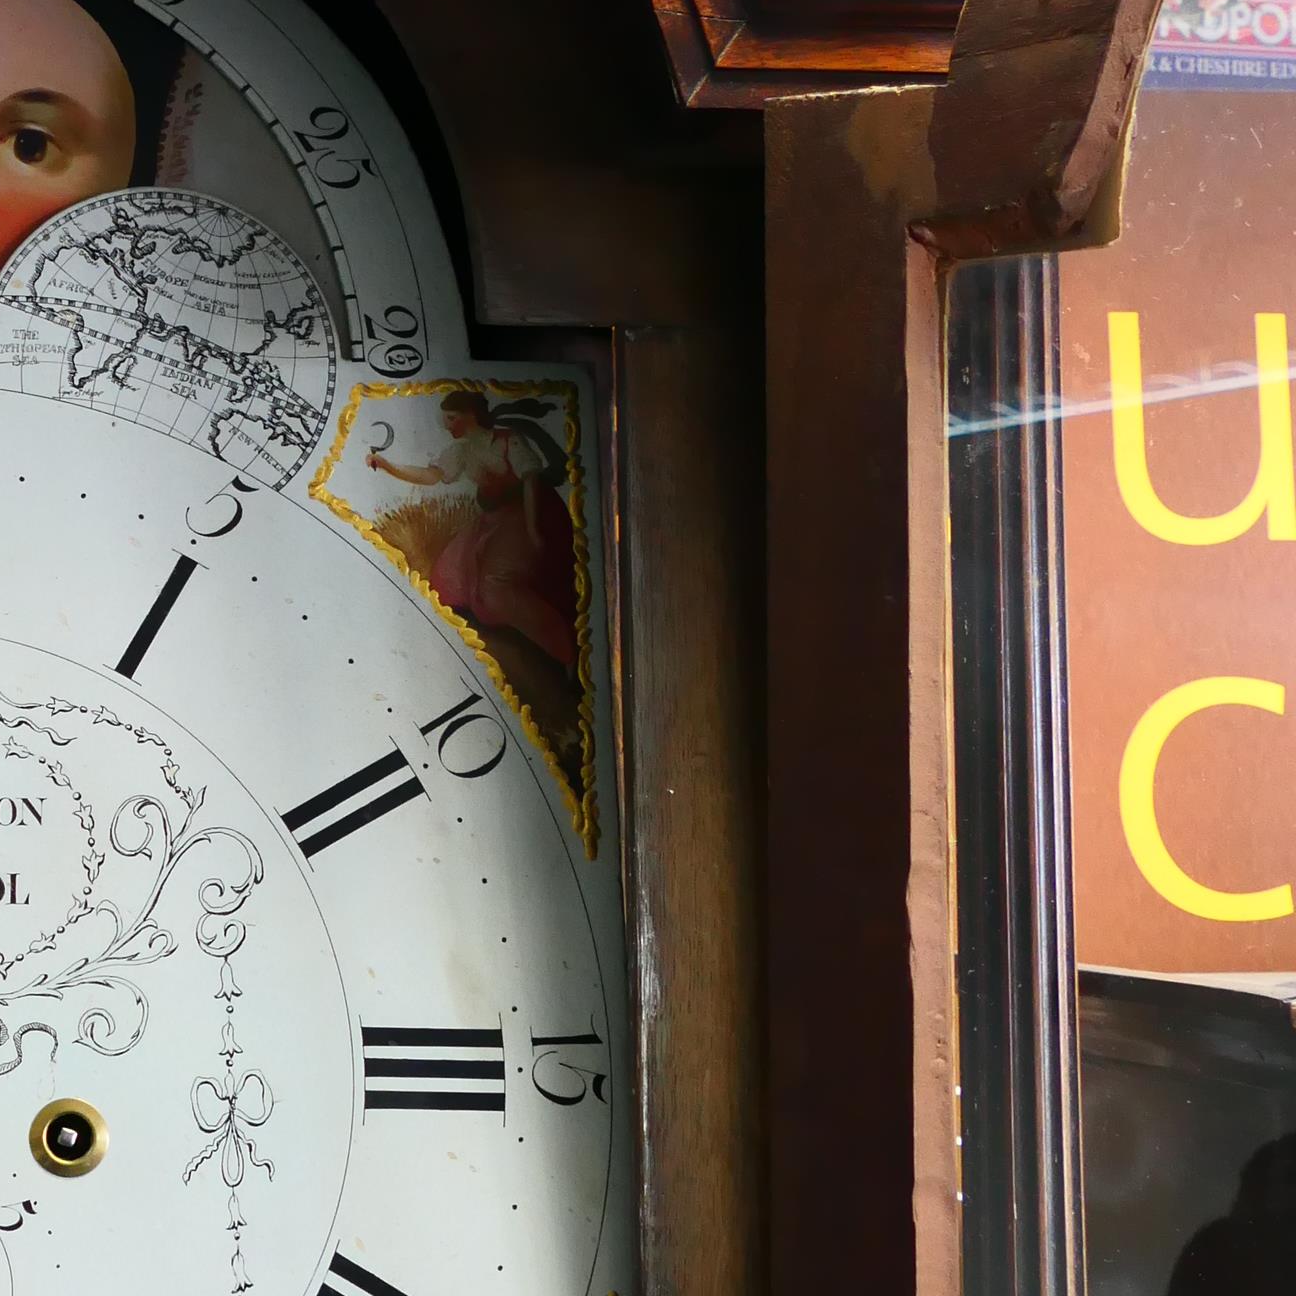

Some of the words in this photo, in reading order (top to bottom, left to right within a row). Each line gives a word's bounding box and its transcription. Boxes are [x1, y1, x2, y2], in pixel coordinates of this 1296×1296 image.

[293, 106, 379, 190] 25
[141, 258, 190, 288] EUROPE
[194, 301, 227, 316] ASIA
[11, 329, 40, 340] THE
[160, 365, 216, 390] INDIAN
[169, 382, 198, 400] SEA
[184, 475, 260, 539] 5
[102, 546, 211, 686] I
[416, 676, 508, 780] 10
[272, 736, 432, 874] II
[358, 1013, 506, 1128] III
[528, 1012, 609, 1106] 15
